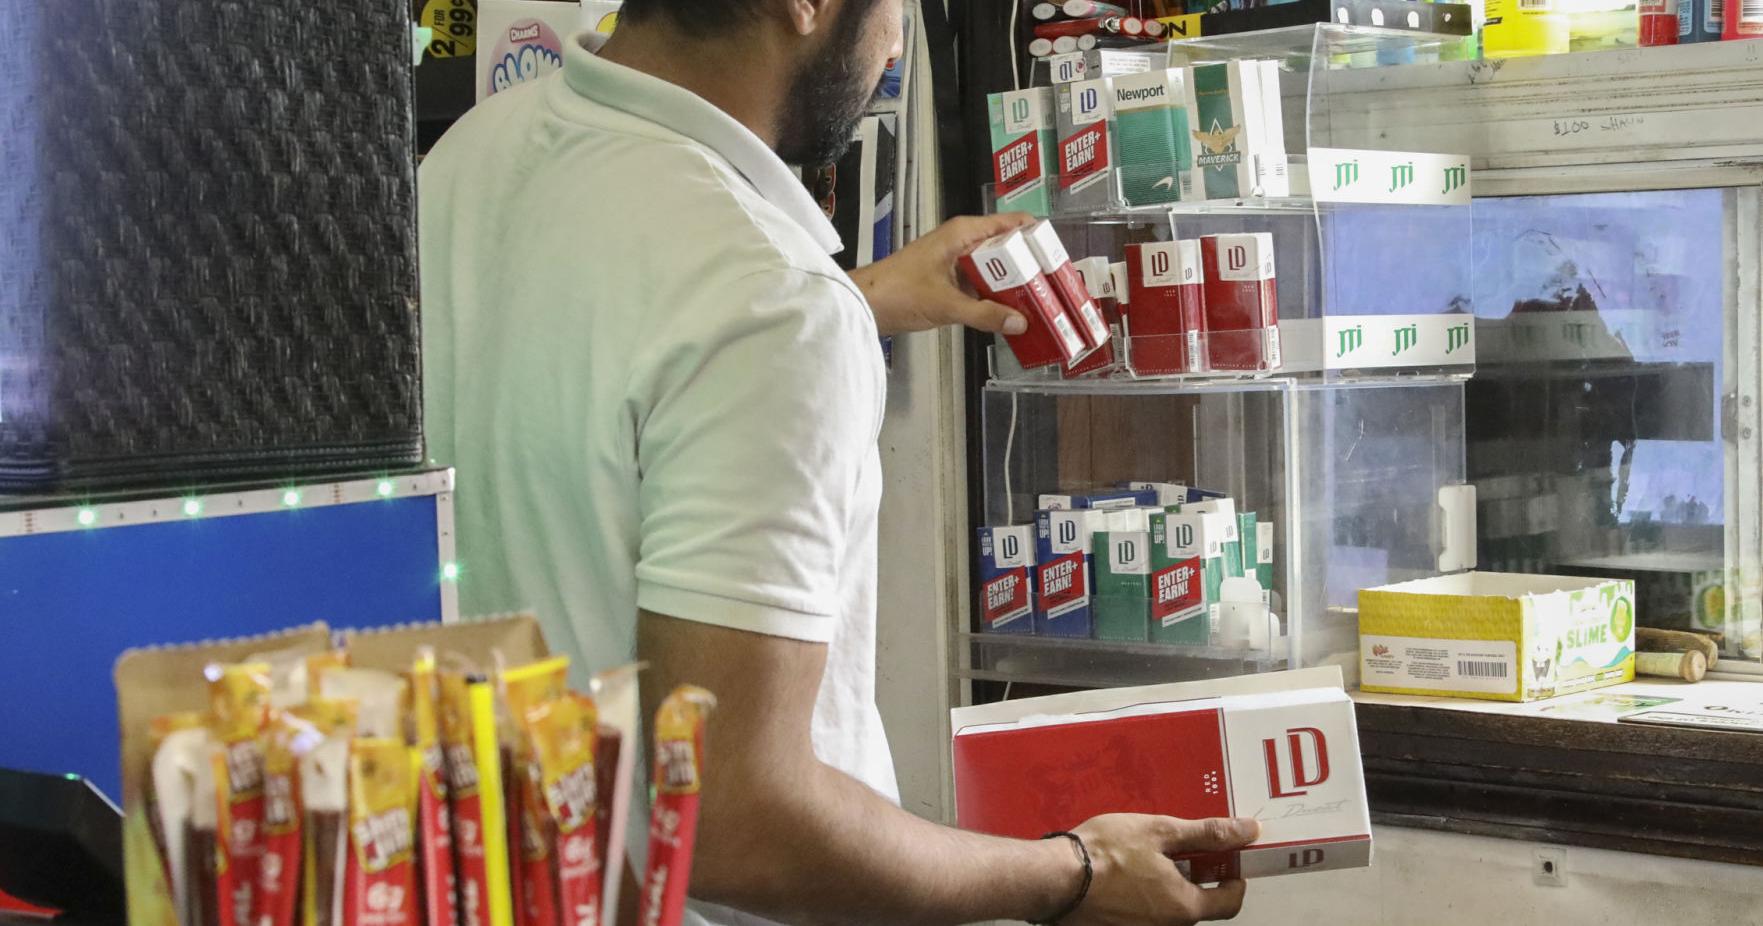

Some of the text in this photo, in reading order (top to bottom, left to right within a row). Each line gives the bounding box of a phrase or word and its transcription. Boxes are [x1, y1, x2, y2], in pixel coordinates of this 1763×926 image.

[1080, 88, 1097, 113] LD
[1116, 84, 1165, 102] Newport
[1012, 98, 1029, 123] LD
[999, 142, 1033, 165] ENTER+
[1065, 130, 1101, 158] ENTER+
[1000, 157, 1028, 183] EARN!
[1066, 147, 1095, 173] EARN!
[1199, 153, 1240, 165] MAVERICK
[986, 257, 1007, 281] LD
[1151, 251, 1169, 277] LD
[1228, 245, 1247, 271] LD
[1059, 520, 1076, 545] LD
[1176, 523, 1193, 549] LD
[1002, 535, 1019, 559] LD
[1118, 540, 1135, 565] LD
[1043, 560, 1079, 582] ENTER+
[1158, 566, 1195, 589] ENTER+
[987, 574, 1019, 597] ENTER+
[1044, 575, 1073, 597] EARN!
[1158, 582, 1189, 604] EARN!
[988, 589, 1014, 610] EARN!
[1567, 624, 1607, 649] SLIME
[1262, 727, 1330, 800] LD
[1289, 848, 1325, 869] LD
